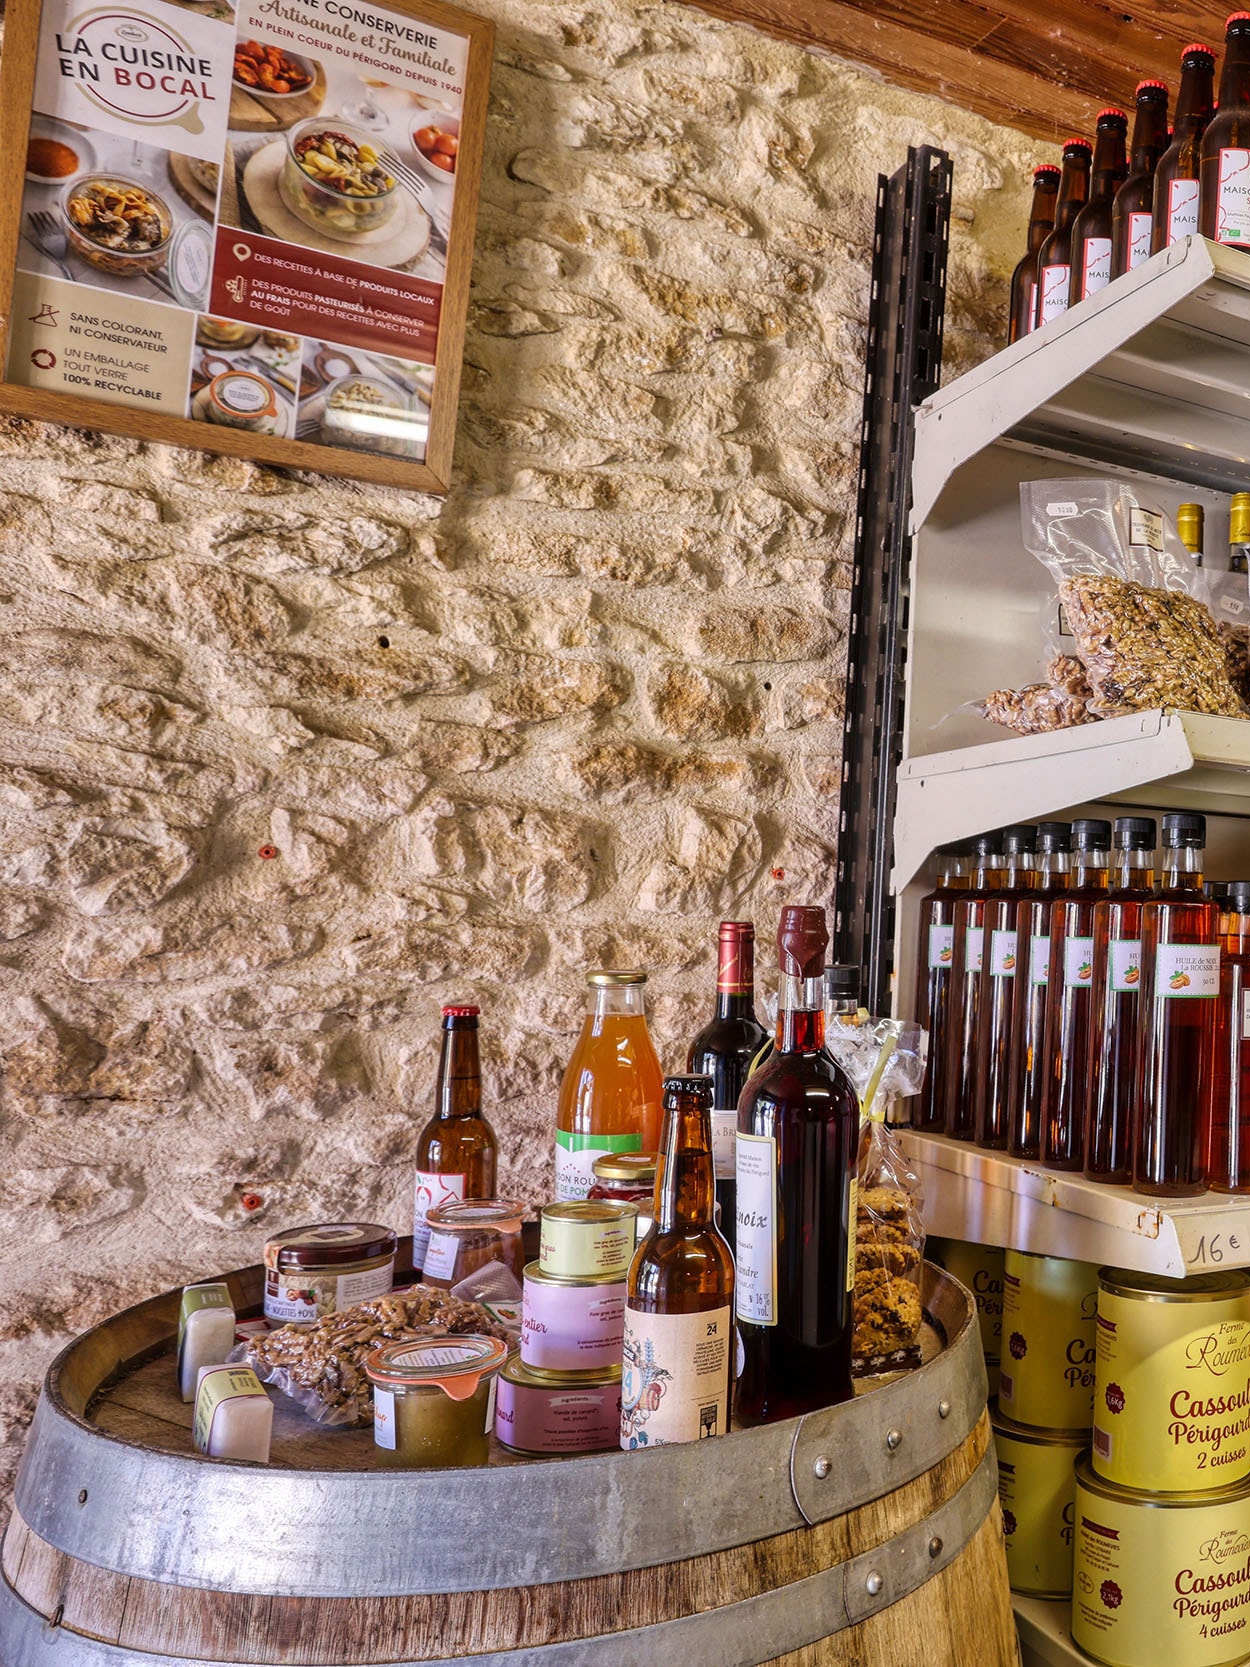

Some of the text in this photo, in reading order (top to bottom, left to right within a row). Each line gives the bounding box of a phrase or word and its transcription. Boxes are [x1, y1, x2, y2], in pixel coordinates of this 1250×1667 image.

[259, 0, 456, 76] Artisanale et Familiale
[325, 1, 438, 49] CONSERVERIE
[55, 34, 212, 77] LA CUISINE
[249, 17, 462, 95] EN PLEIN COEUR DU PÉRIGORD DEPUIS 1940
[59, 58, 216, 100] EN BOCAL
[1174, 216, 1197, 224] MAIS
[254, 253, 272, 265] DES
[273, 258, 314, 276] RECETTES
[324, 270, 344, 284] BASE
[346, 276, 358, 287] DE
[359, 280, 398, 297] PRODUITS
[400, 290, 434, 306] LOCAUX
[250, 300, 262, 310] DE
[251, 290, 420, 337] AU FRAIS POUR DES RECETTES AVEC PLUS
[252, 278, 270, 290] DES
[271, 284, 314, 301] PRODUITS
[314, 294, 365, 313] PASTEURISÉS
[374, 308, 424, 328] CONSERVER
[69, 325, 168, 354] NI CONSERVATEUR
[70, 312, 164, 342] SANS COLORANT,
[64, 348, 150, 373] UN EMBALLAGE
[64, 360, 128, 382] TOUT VERRE
[62, 372, 162, 400] 100% RECYCLABLE
[706, 1324, 718, 1336] 24
[1218, 1322, 1244, 1336] Ferme
[1228, 1336, 1237, 1346] des
[1196, 1446, 1246, 1469] 2 cuisses
[1220, 1530, 1238, 1540] Ferme
[1199, 1616, 1246, 1638] 4 cuisses
